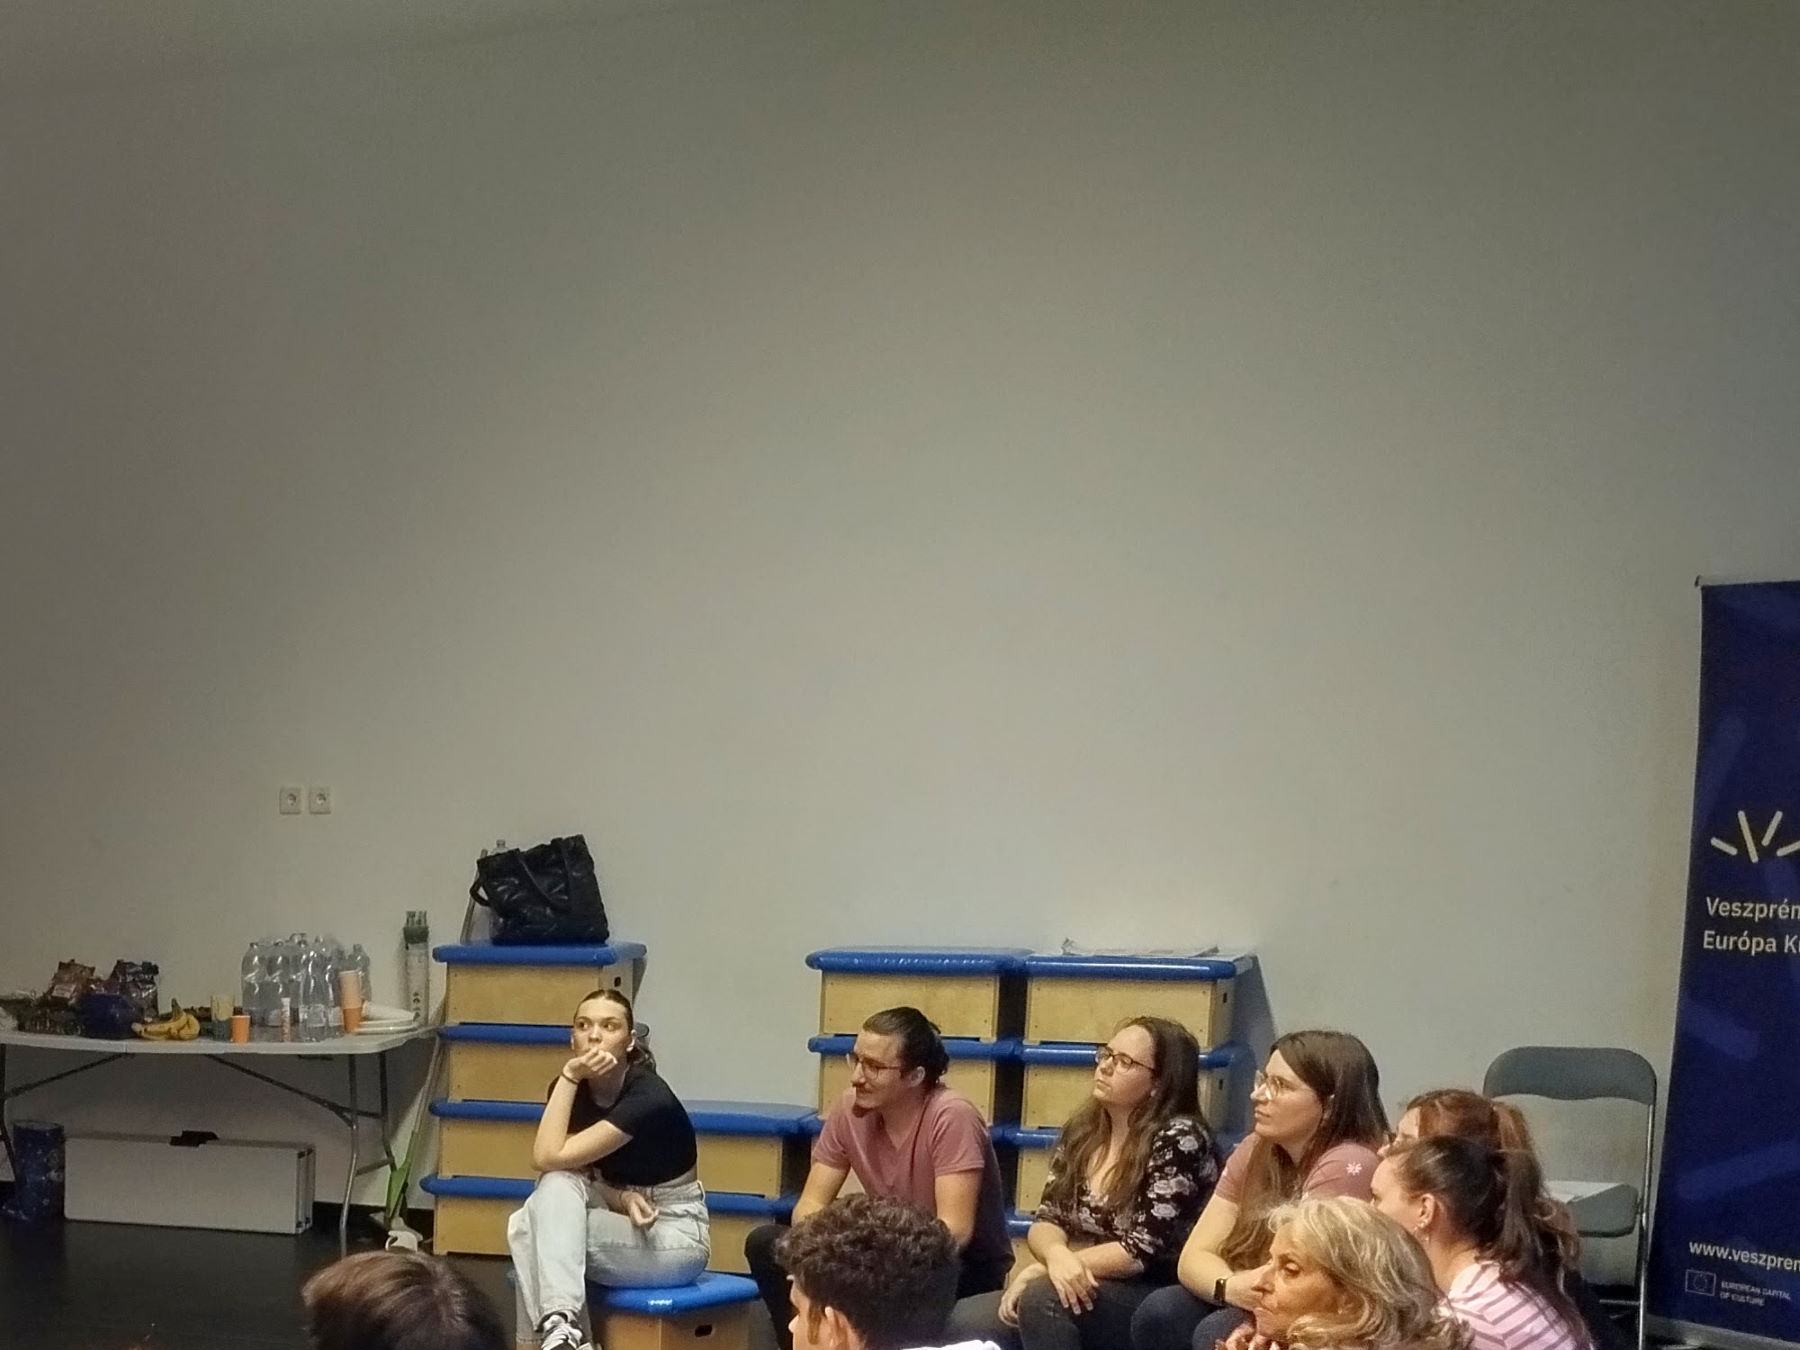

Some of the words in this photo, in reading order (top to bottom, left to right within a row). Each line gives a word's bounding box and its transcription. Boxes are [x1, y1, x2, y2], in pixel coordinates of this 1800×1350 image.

[1703, 930, 1777, 956] Európa
[1784, 934, 1800, 953] K
[1720, 1291, 1730, 1299] OF
[1721, 1281, 1760, 1294] EUROPEAN
[1762, 1288, 1791, 1300] CAPITAL
